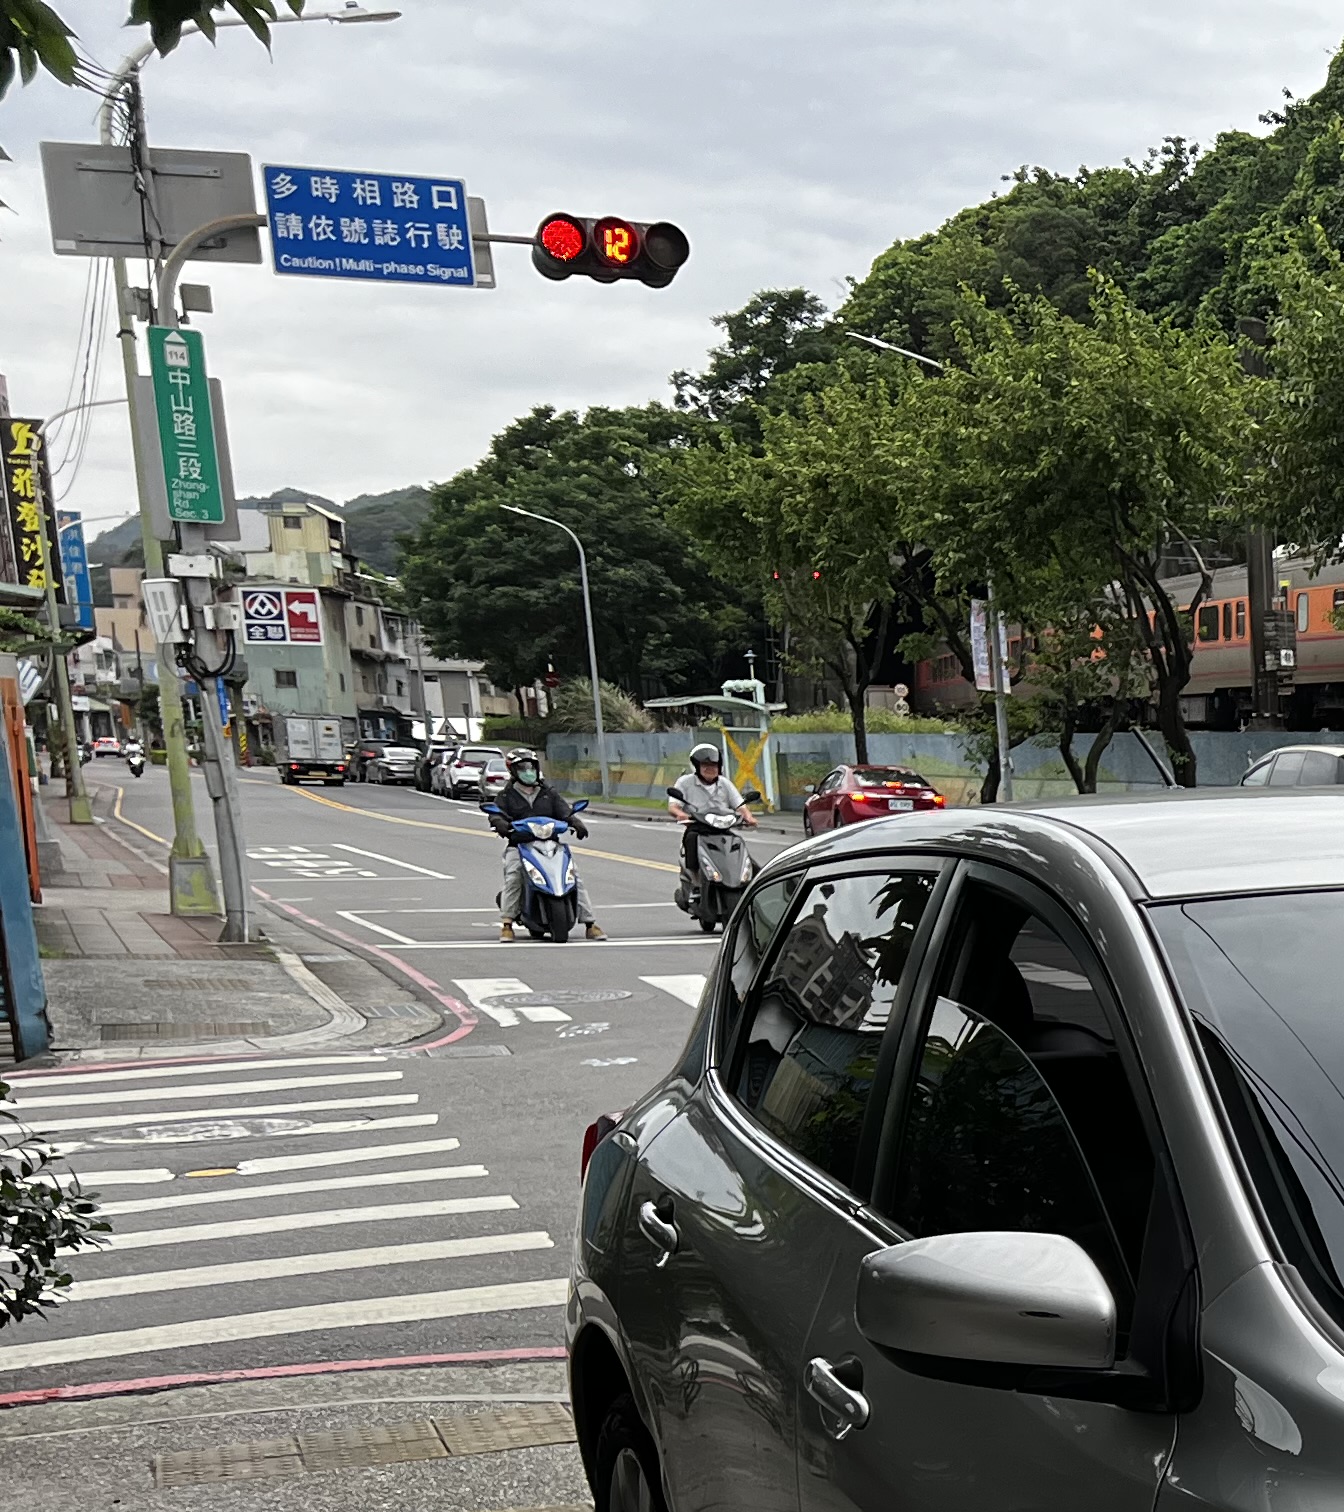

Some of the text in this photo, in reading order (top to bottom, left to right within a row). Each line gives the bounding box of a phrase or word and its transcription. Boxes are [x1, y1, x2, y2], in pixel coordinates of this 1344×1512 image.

[271, 172, 459, 211] 多時相路口
[274, 212, 465, 251] 請依號誌行駛
[605, 227, 629, 263] 12
[427, 263, 468, 281] Signal
[168, 350, 186, 361] 114
[168, 368, 203, 481] 中山路三段
[202, 509, 209, 520] 3
